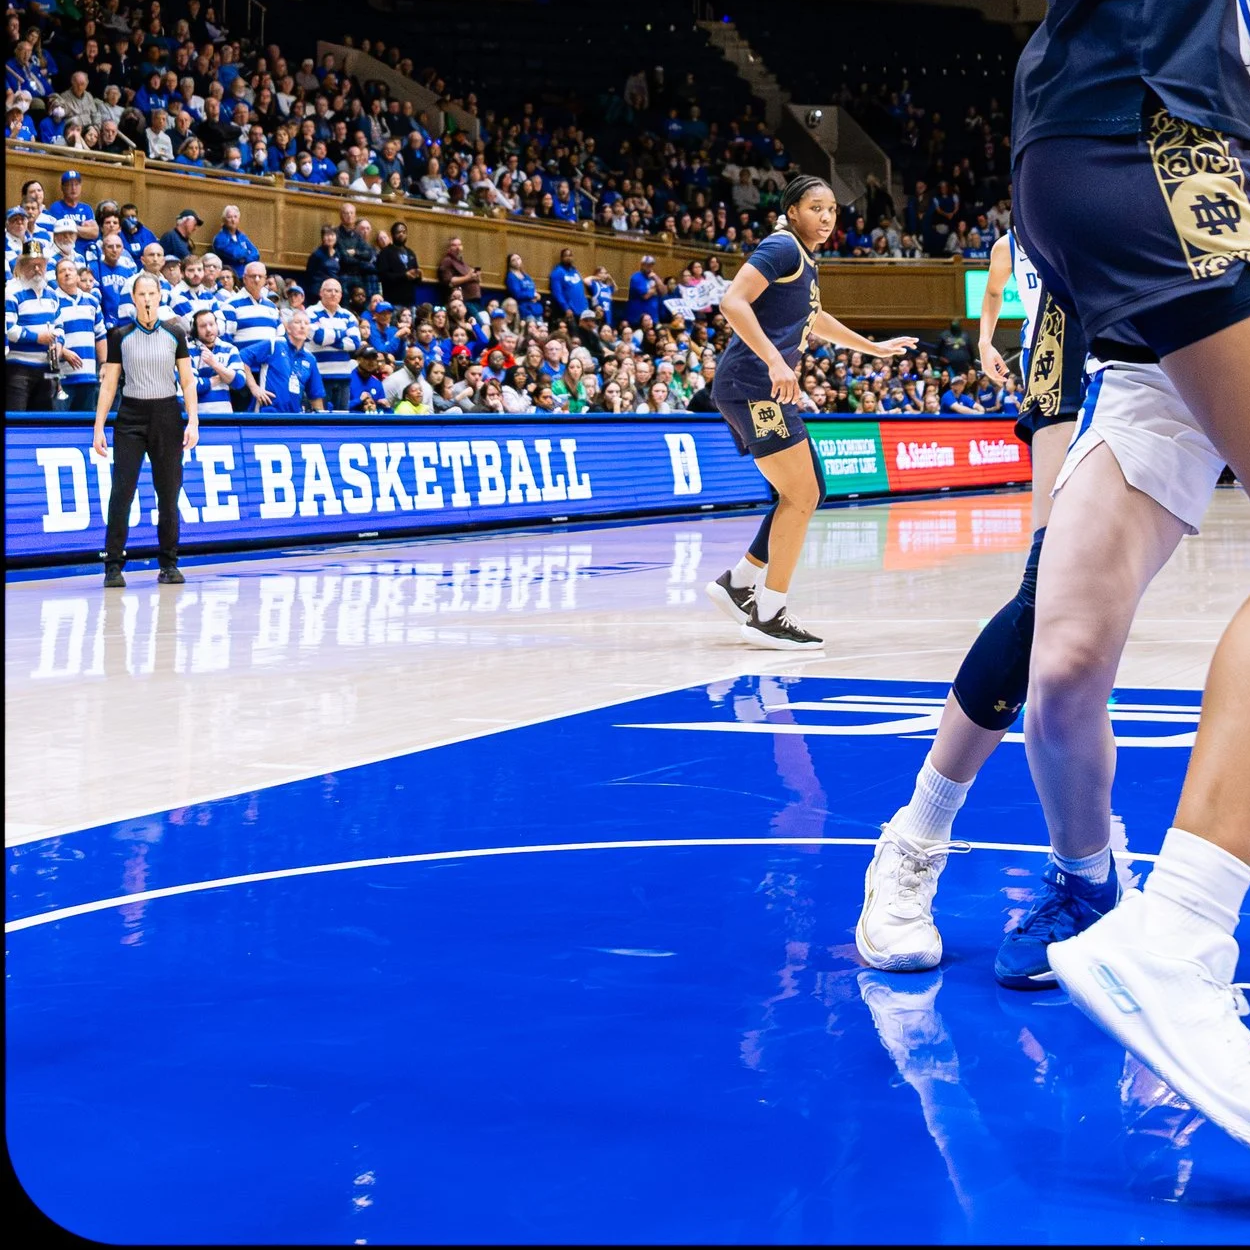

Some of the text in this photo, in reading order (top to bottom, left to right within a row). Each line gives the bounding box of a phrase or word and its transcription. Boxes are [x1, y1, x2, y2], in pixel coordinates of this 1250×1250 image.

[819, 439, 876, 456] OLD DOMINION
[824, 457, 877, 475] FREIGHT LINE
[256, 438, 592, 519] BASKETBALL
